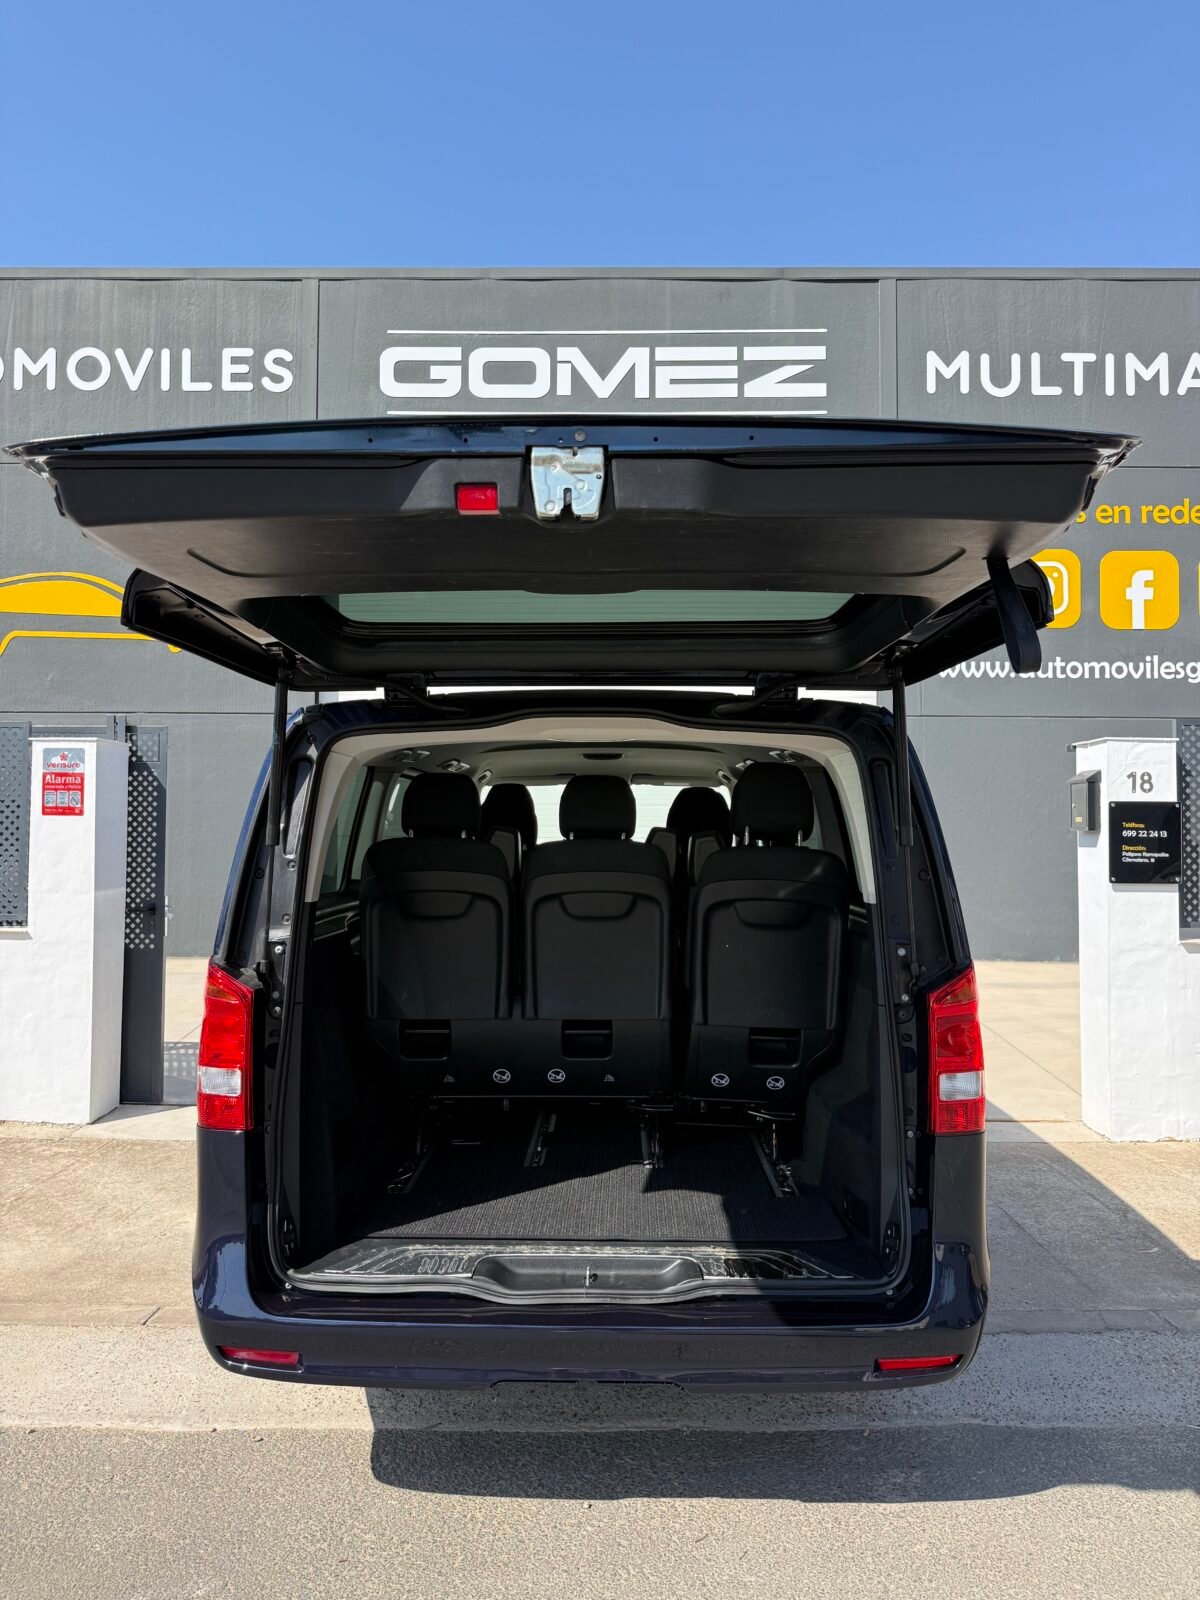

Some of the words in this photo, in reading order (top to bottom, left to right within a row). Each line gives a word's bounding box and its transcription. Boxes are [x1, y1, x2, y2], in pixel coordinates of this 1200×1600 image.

[0, 346, 294, 393] MOVILES
[379, 345, 827, 399] GOMEZ
[1095, 503, 1131, 525] en
[45, 774, 81, 784] Alarma
[1126, 771, 1154, 794] 18
[1122, 830, 1137, 838] 699
[1138, 830, 1148, 838] 22
[1149, 830, 1159, 838] 24
